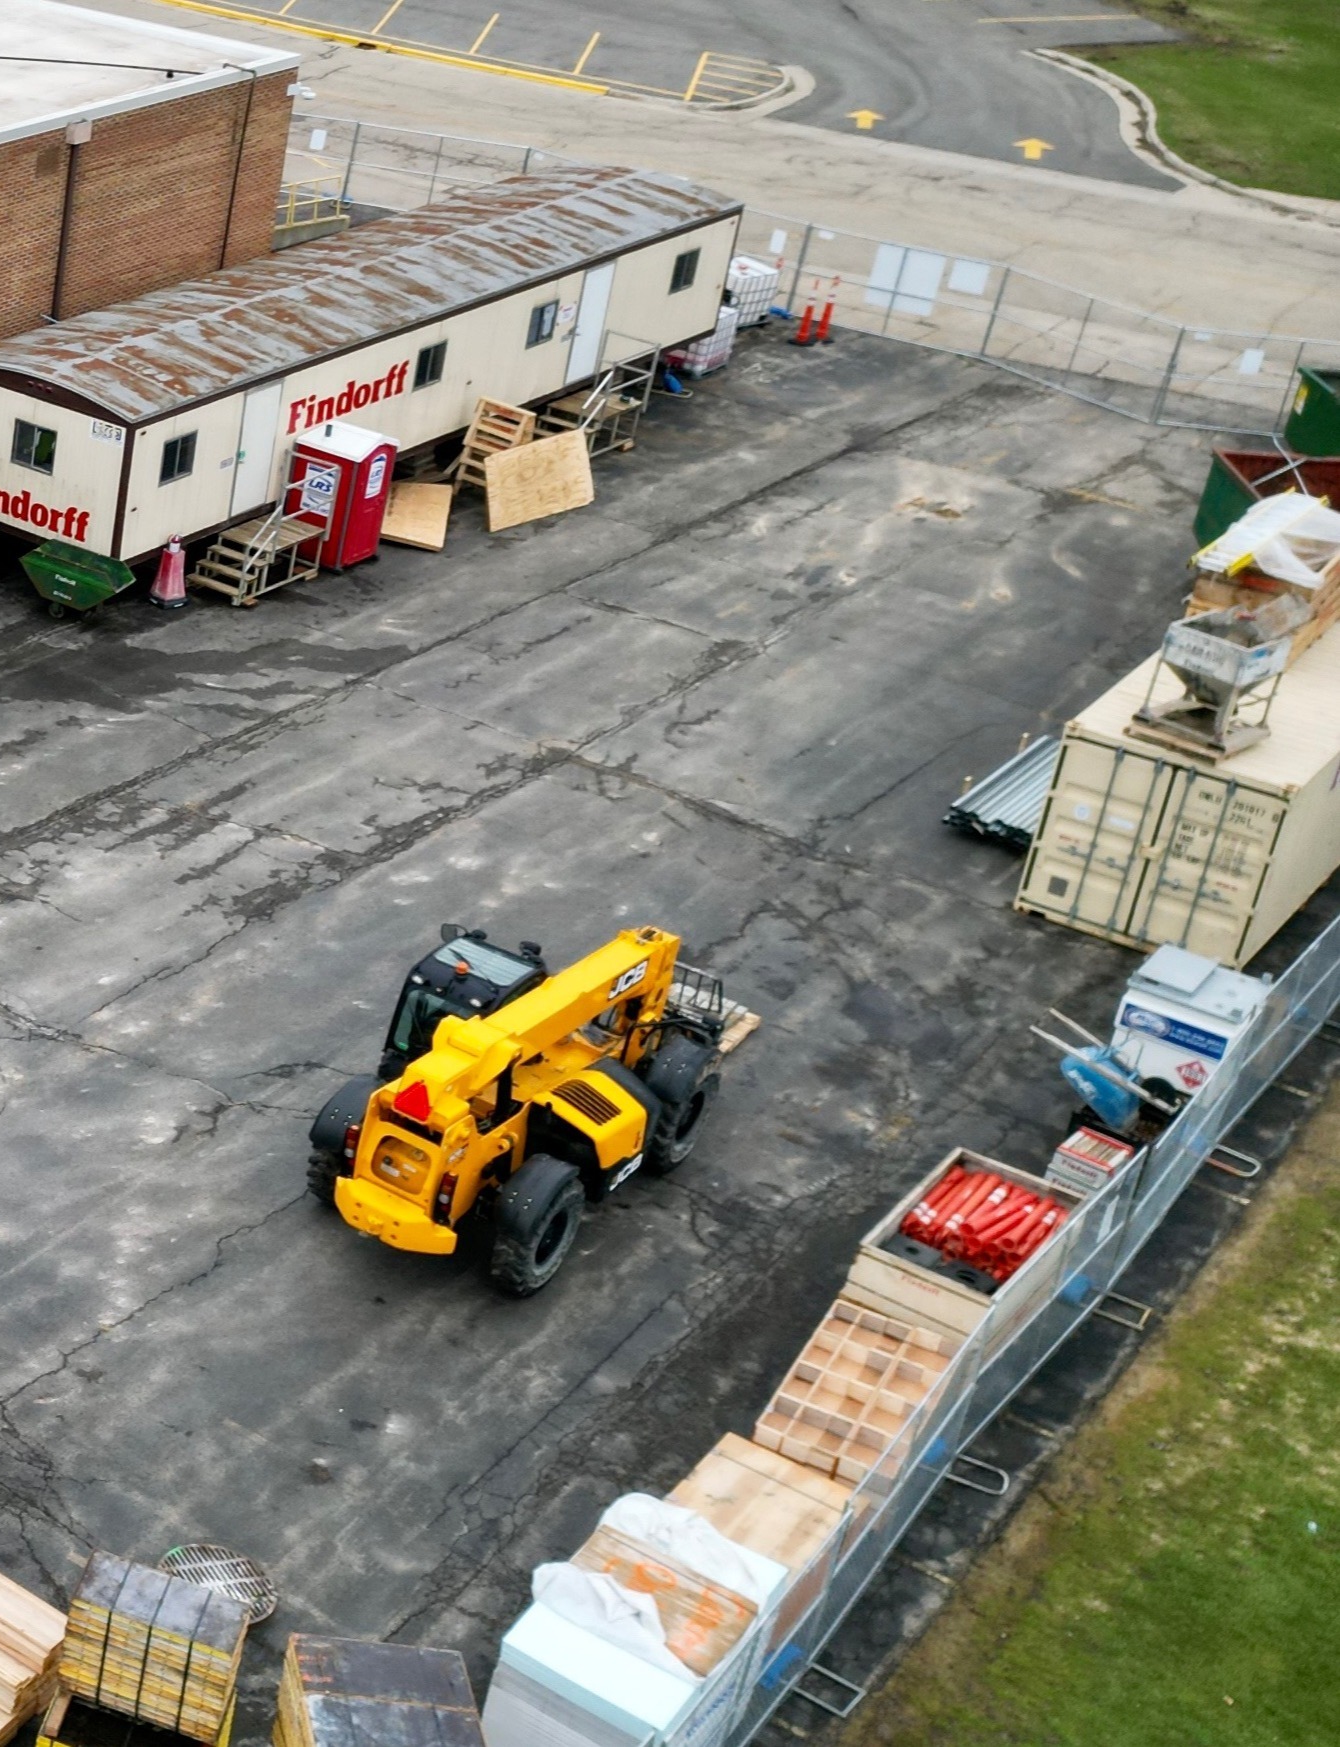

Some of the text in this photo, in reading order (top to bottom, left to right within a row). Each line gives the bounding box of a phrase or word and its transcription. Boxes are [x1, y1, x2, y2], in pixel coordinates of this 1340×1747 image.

[285, 359, 410, 436] Findorff
[308, 479, 333, 493] LRS
[608, 960, 648, 999] JCB
[609, 1153, 643, 1191] JCB
